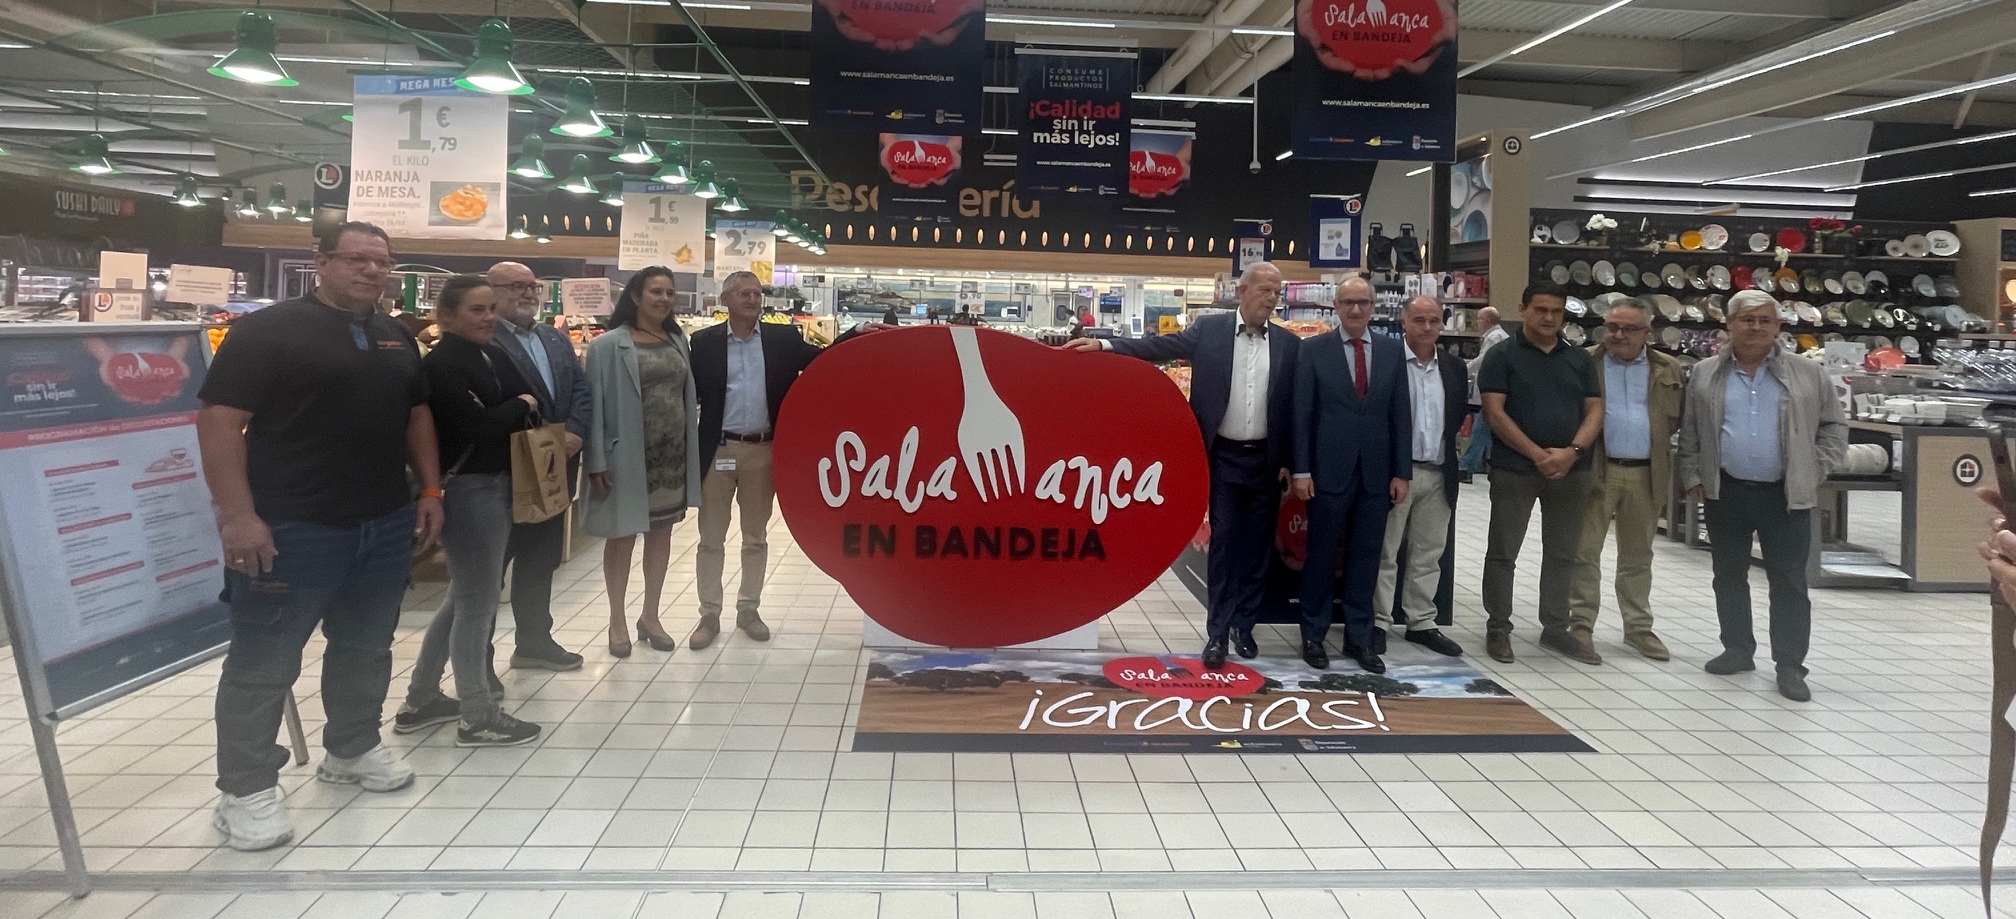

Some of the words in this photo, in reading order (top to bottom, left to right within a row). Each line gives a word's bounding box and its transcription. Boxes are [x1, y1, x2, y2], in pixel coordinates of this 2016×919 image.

[1332, 30, 1348, 41] EN
[1353, 31, 1411, 43] BANDEJA
[840, 70, 955, 82] www.salamancaenbandeja.es
[400, 79, 430, 91] MEGA
[1028, 100, 1121, 120] ¡Calidad
[1321, 99, 1430, 110] www.salamancaenbandeja.es
[1052, 115, 1079, 130] sin
[1083, 115, 1096, 130] ir
[1033, 130, 1071, 144] más
[1074, 131, 1120, 148] lejos!
[392, 155, 404, 166] EL
[407, 155, 430, 167] KILO
[355, 169, 421, 183] NARANJA
[356, 185, 374, 198] DE
[377, 186, 421, 199] MESA.
[56, 190, 88, 212] SUSHI
[91, 194, 121, 215] DAILY
[842, 523, 897, 558] EN
[914, 524, 1106, 560] BANDEJA
[1019, 691, 1390, 732] ¡Gracias!
